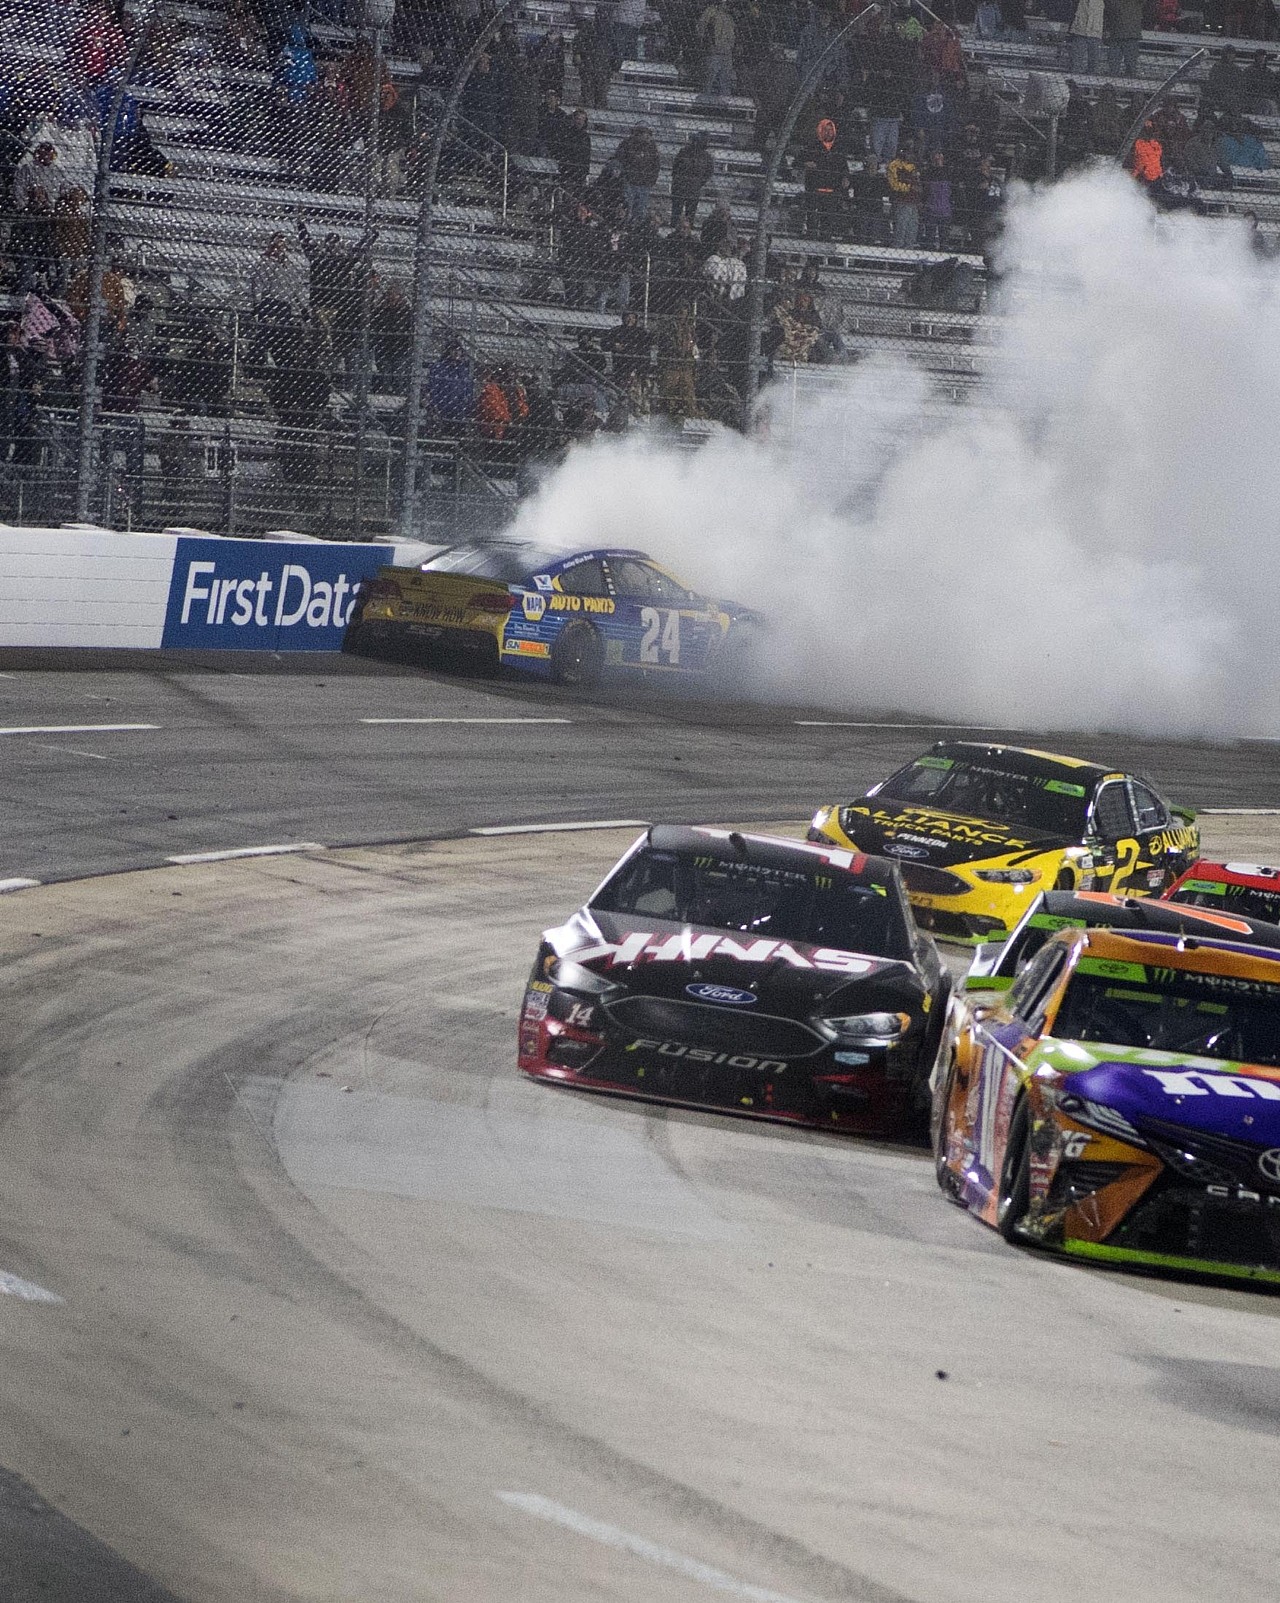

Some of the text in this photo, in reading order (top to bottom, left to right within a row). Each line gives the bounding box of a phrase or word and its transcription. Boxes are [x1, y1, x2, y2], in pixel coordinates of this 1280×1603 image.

[181, 561, 273, 627] First
[551, 594, 616, 614] AUTO PARTS
[640, 605, 681, 664] 24
[849, 806, 1032, 849] ALLIANCE
[873, 818, 984, 846] TRUCK PARTS
[897, 833, 949, 848] PENNZOIL
[719, 860, 807, 882] MONSTER
[1108, 838, 1141, 895] 2
[699, 984, 745, 1001] Ford
[565, 1002, 595, 1027] 14
[626, 1038, 789, 1074] FUSION
